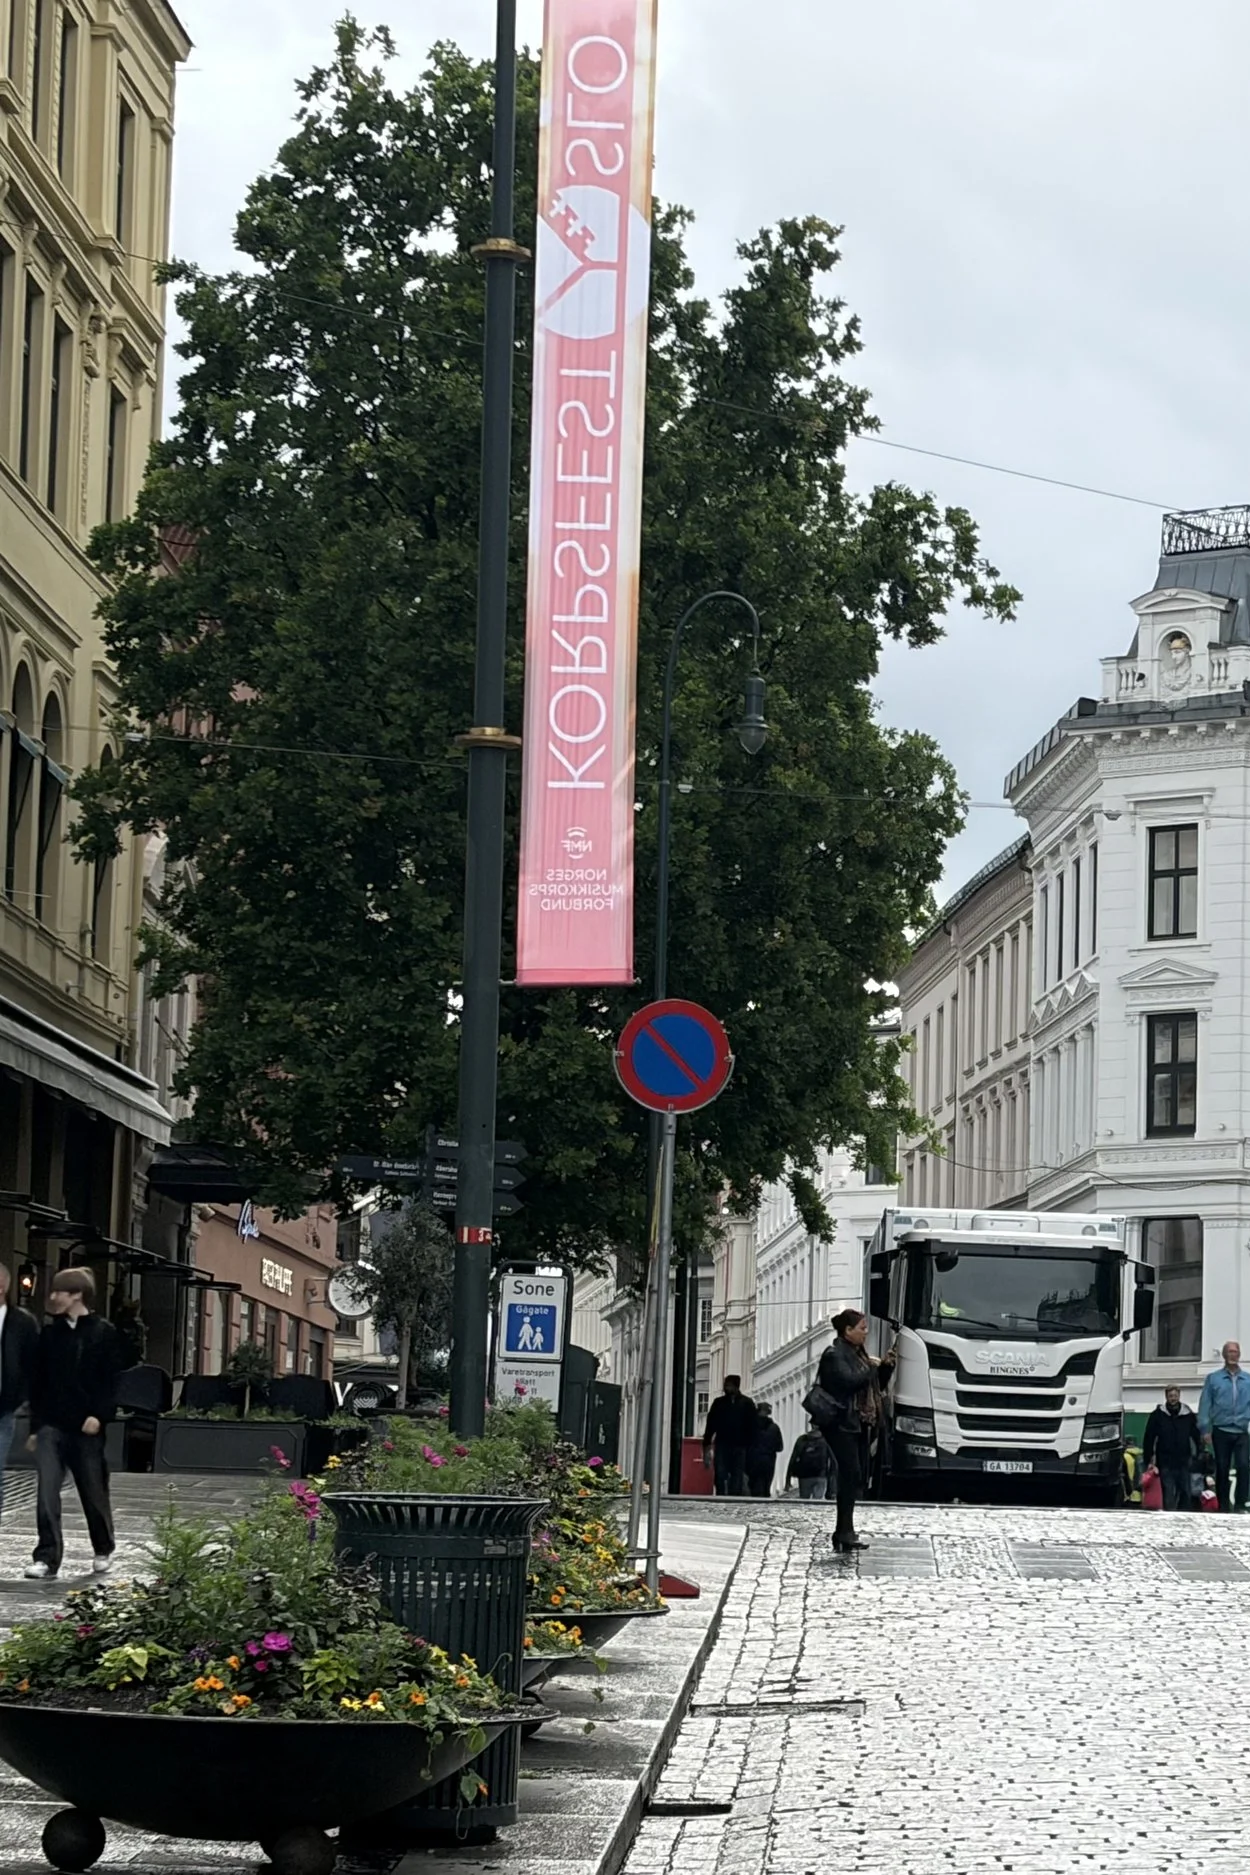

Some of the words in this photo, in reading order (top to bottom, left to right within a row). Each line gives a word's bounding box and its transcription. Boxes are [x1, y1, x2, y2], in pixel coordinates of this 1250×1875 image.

[513, 1280, 555, 1296] Sone
[515, 1305, 549, 1316] Gågate
[975, 1350, 1050, 1367] SCANIA
[501, 1367, 555, 1378] Varetransport
[990, 1462, 1001, 1471] GA
